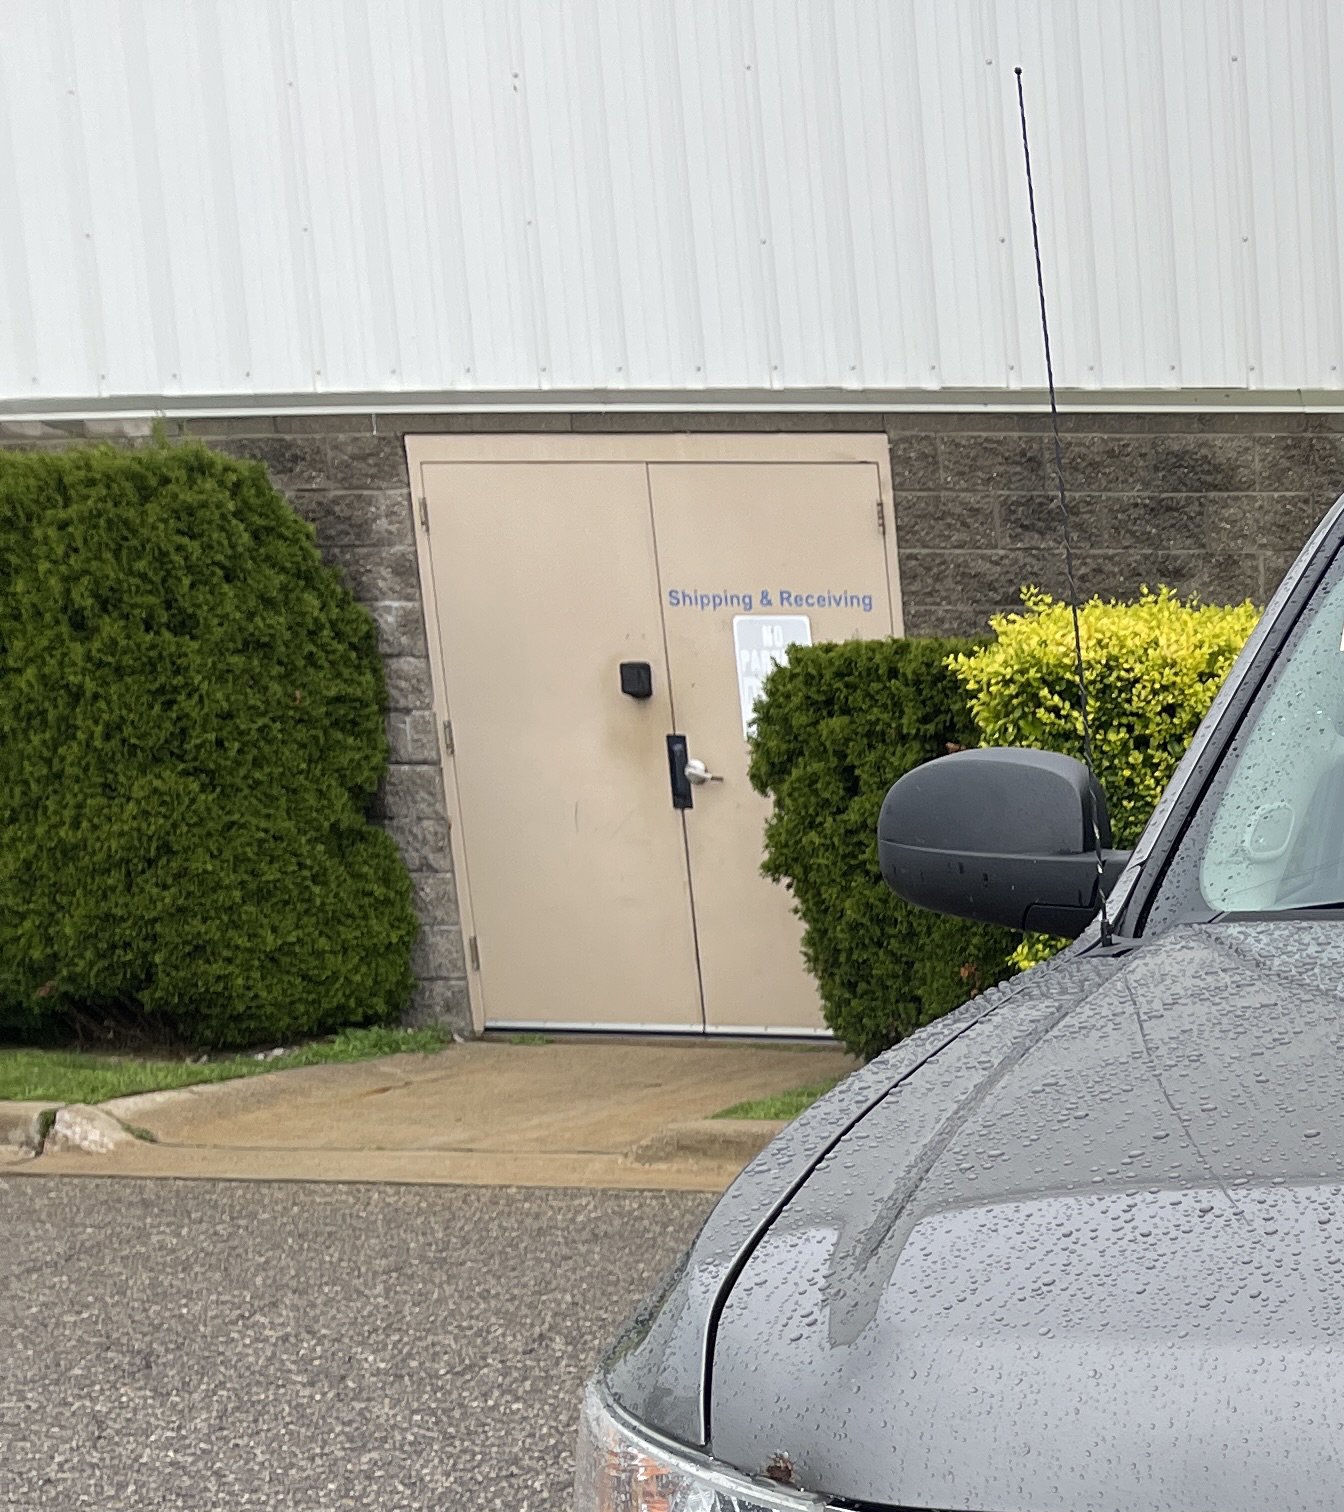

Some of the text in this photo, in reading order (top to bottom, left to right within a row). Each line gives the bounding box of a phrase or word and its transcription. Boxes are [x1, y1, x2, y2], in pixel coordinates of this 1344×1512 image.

[668, 589, 874, 612] Shipping & Receiving
[762, 624, 784, 647] NO
